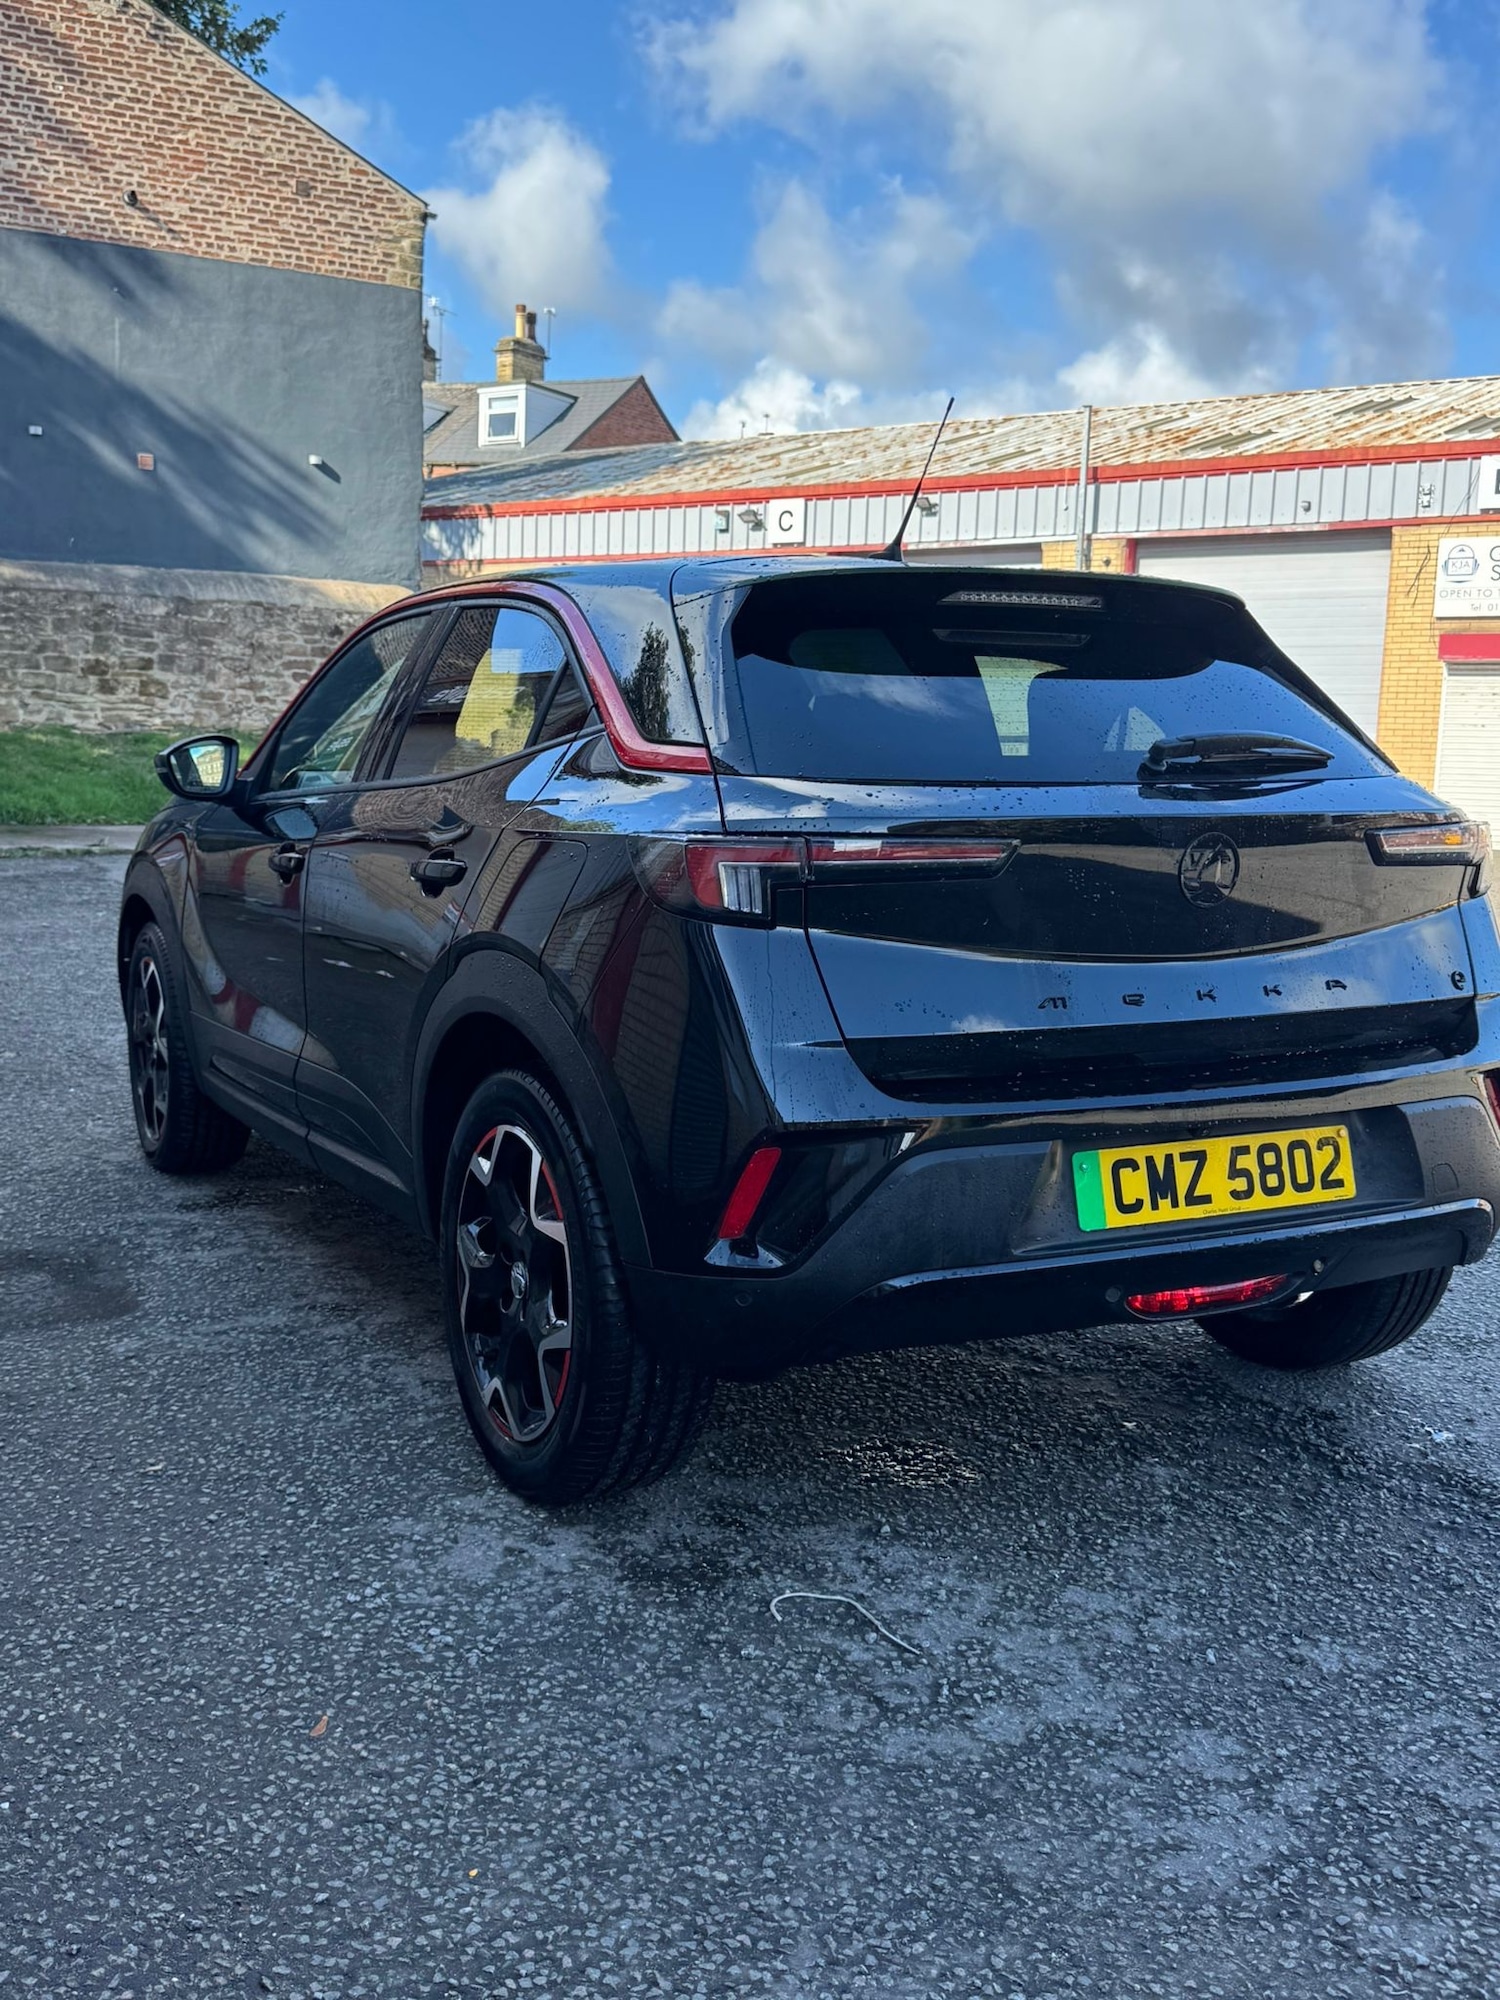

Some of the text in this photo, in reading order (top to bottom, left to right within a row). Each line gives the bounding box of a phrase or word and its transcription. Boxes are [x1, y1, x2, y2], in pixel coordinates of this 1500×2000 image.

[778, 510, 794, 532] C
[1451, 560, 1471, 569] KJA
[1439, 588, 1493, 599] OPEN TO
[1111, 1136, 1345, 1215] CMZ 5802
